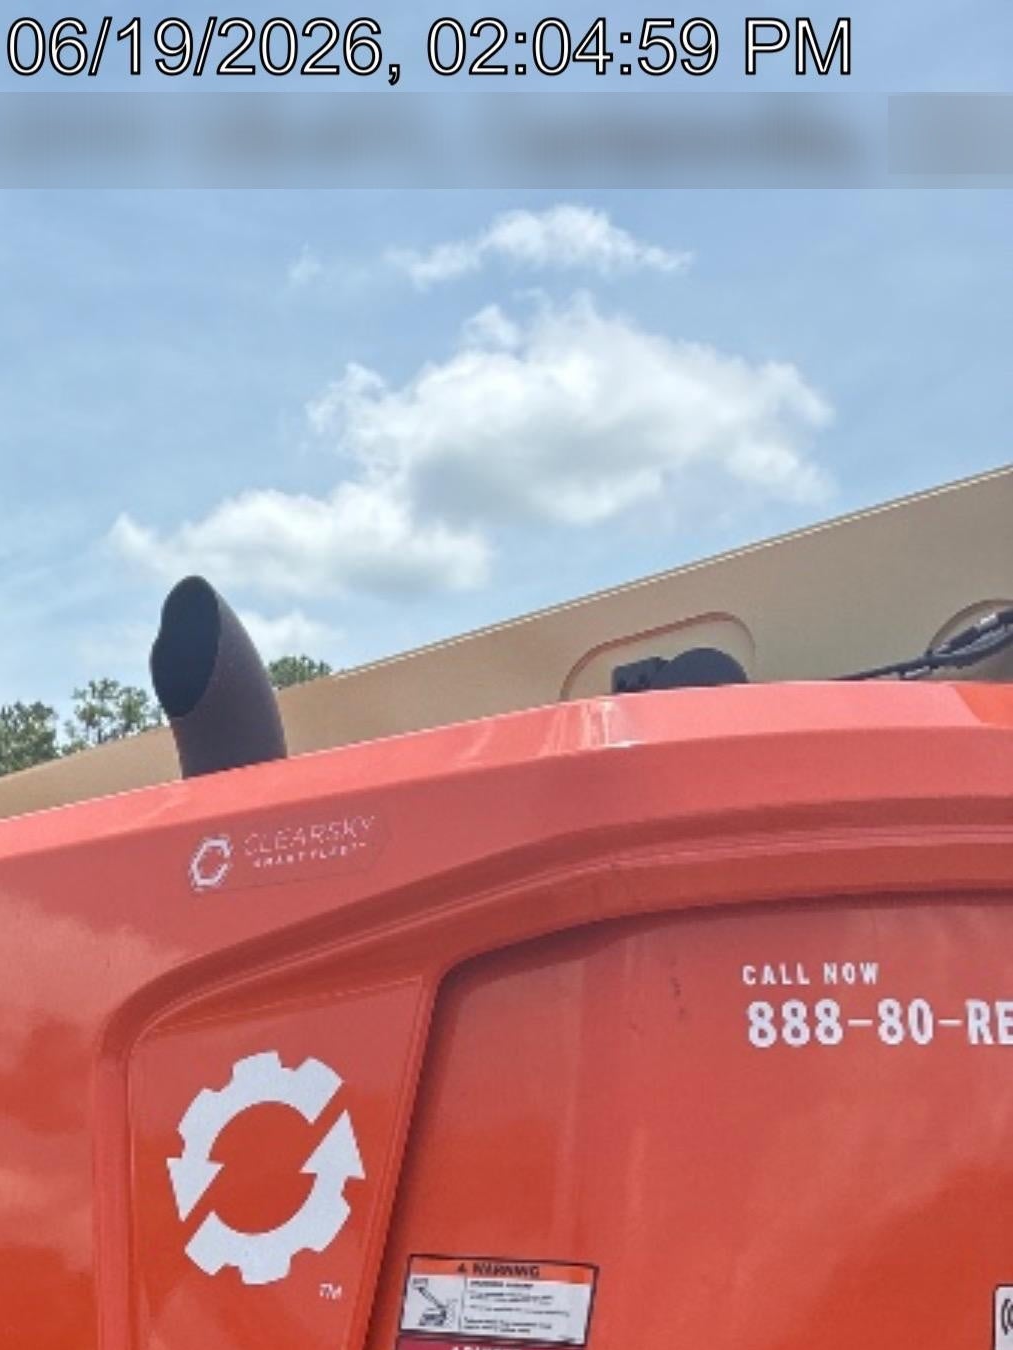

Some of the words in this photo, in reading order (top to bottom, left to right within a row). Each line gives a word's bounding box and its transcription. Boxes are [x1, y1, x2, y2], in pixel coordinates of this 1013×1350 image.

[244, 815, 375, 856] CLEARSKY
[742, 962, 811, 985] CALL
[823, 962, 880, 985] NOW
[747, 997, 1013, 1048] 888-80-RE
[473, 1262, 540, 1278] WARNING
